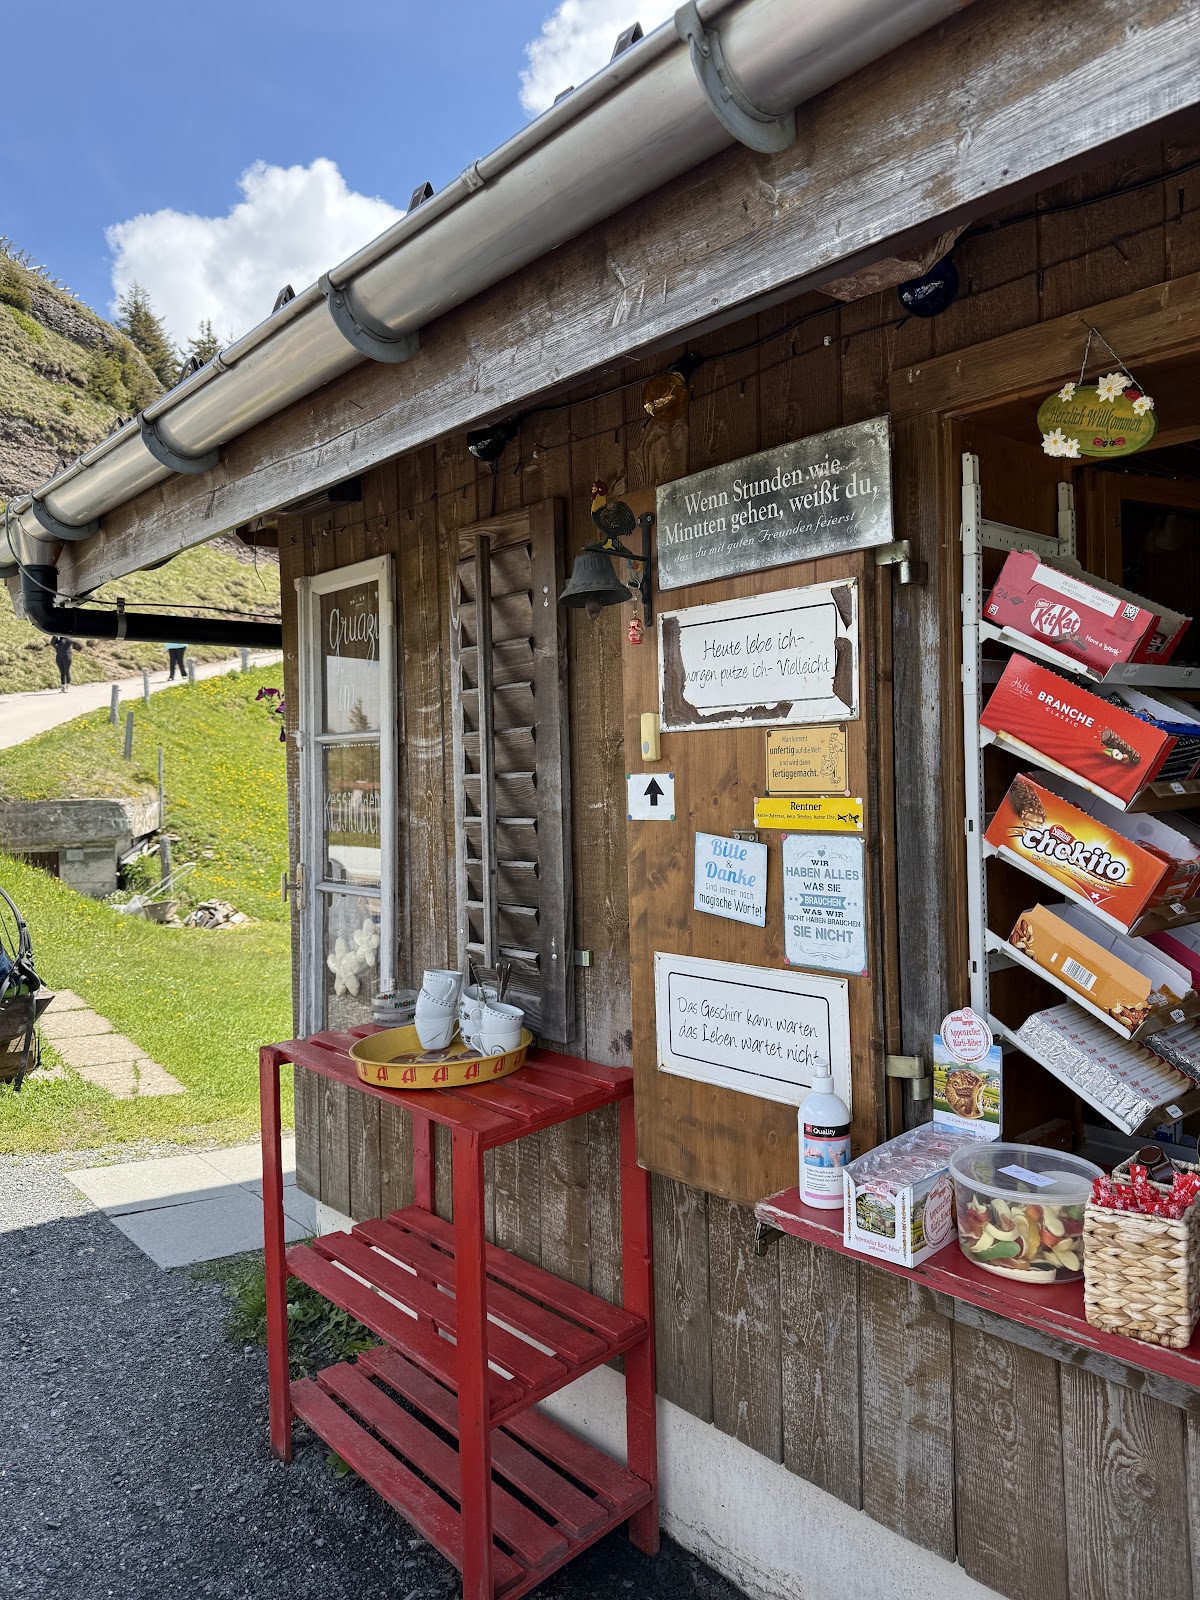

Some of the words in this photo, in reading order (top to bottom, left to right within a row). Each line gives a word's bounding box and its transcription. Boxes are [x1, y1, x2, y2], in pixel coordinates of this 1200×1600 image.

[1048, 404, 1086, 426] Herzlich
[1087, 407, 1143, 434] Willkommen
[684, 490, 728, 515] Wenn
[733, 466, 802, 502] Stunden
[808, 453, 841, 479] wie
[664, 517, 726, 546] Minuten
[731, 501, 784, 533] gehen,
[789, 480, 840, 513] weißt
[845, 474, 879, 498] du,
[674, 549, 693, 563] dass
[695, 545, 707, 559] du
[709, 542, 724, 557] mit
[727, 536, 755, 554] guten
[758, 523, 813, 543] Freunden
[995, 588, 1008, 600] 24
[1032, 604, 1081, 636] KitKat
[703, 639, 741, 660] Heute
[746, 633, 773, 655] lebe
[1085, 634, 1099, 646] Have
[720, 666, 749, 686] putze
[777, 655, 830, 676] Vielleicht
[1037, 691, 1095, 728] BRANCHE
[1045, 706, 1078, 728] CLASSIC
[769, 745, 795, 756] unfertig
[772, 768, 819, 780] fertiggemacht.
[790, 802, 822, 811] Rentner
[711, 838, 748, 862] Bitte
[726, 860, 733, 869] &
[811, 859, 829, 867] WIR
[705, 861, 756, 887] Danke
[786, 866, 821, 879] HABEN
[824, 868, 859, 881] ALLES
[705, 882, 718, 892] sind
[719, 884, 738, 896] immer
[740, 889, 754, 900] noch
[803, 882, 825, 892] WAS
[827, 883, 841, 893] SIE
[699, 893, 732, 911] magische
[733, 899, 762, 918] Worte!
[804, 895, 842, 907] BRAUCHEN
[787, 914, 805, 922] NICHT
[806, 915, 827, 925] HABEN
[827, 918, 861, 928] BRAUCHEN
[802, 908, 824, 916] WAS
[826, 909, 844, 918] WIR
[793, 925, 812, 939] SIE
[815, 927, 854, 943] NICHT
[677, 996, 698, 1015] Das
[700, 999, 743, 1023] Geschirr
[746, 1008, 773, 1030] kann
[776, 1018, 818, 1038] warten
[678, 1019, 698, 1040] das
[701, 1023, 738, 1048] Leben
[741, 1037, 783, 1059] wartet
[813, 1127, 836, 1137] Quality
